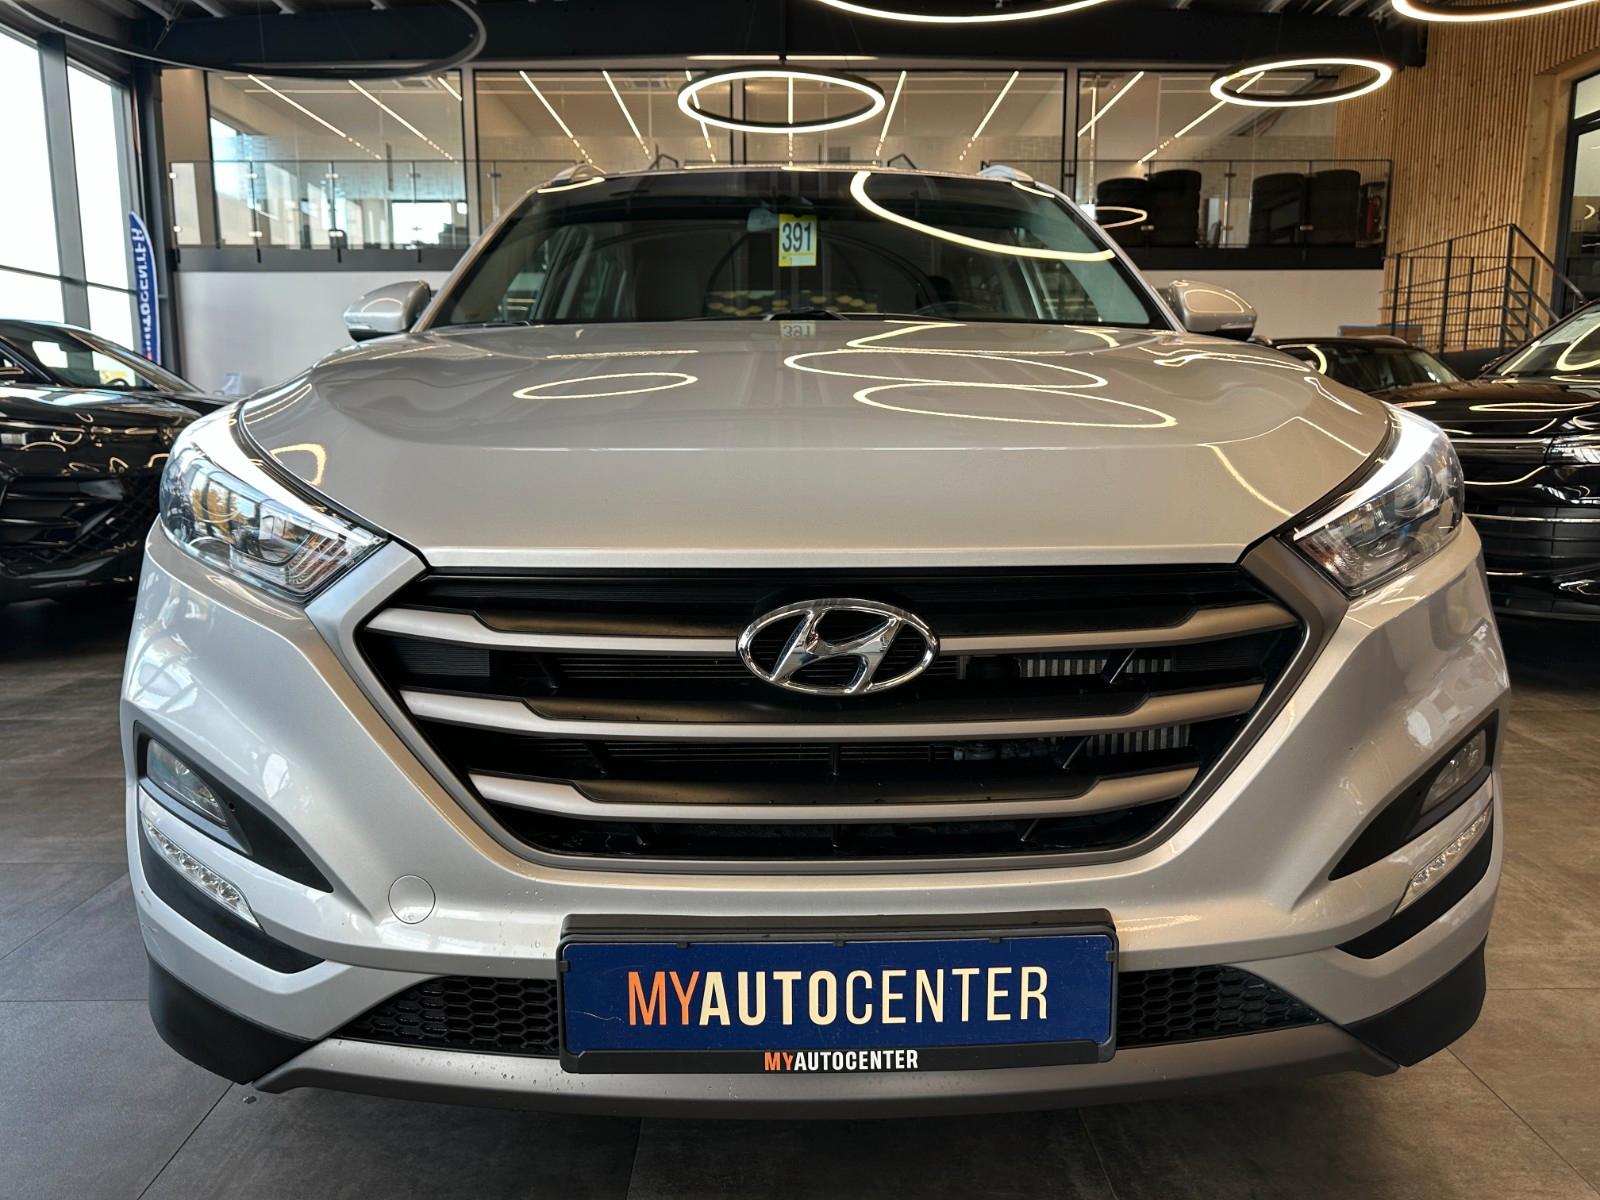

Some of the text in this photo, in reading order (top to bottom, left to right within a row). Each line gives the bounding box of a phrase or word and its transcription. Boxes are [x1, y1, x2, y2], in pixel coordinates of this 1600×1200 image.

[782, 222, 812, 252] 391
[628, 966, 1049, 1026] MYAUTOCENTER
[764, 1050, 919, 1071] MYAUTOCENTER
